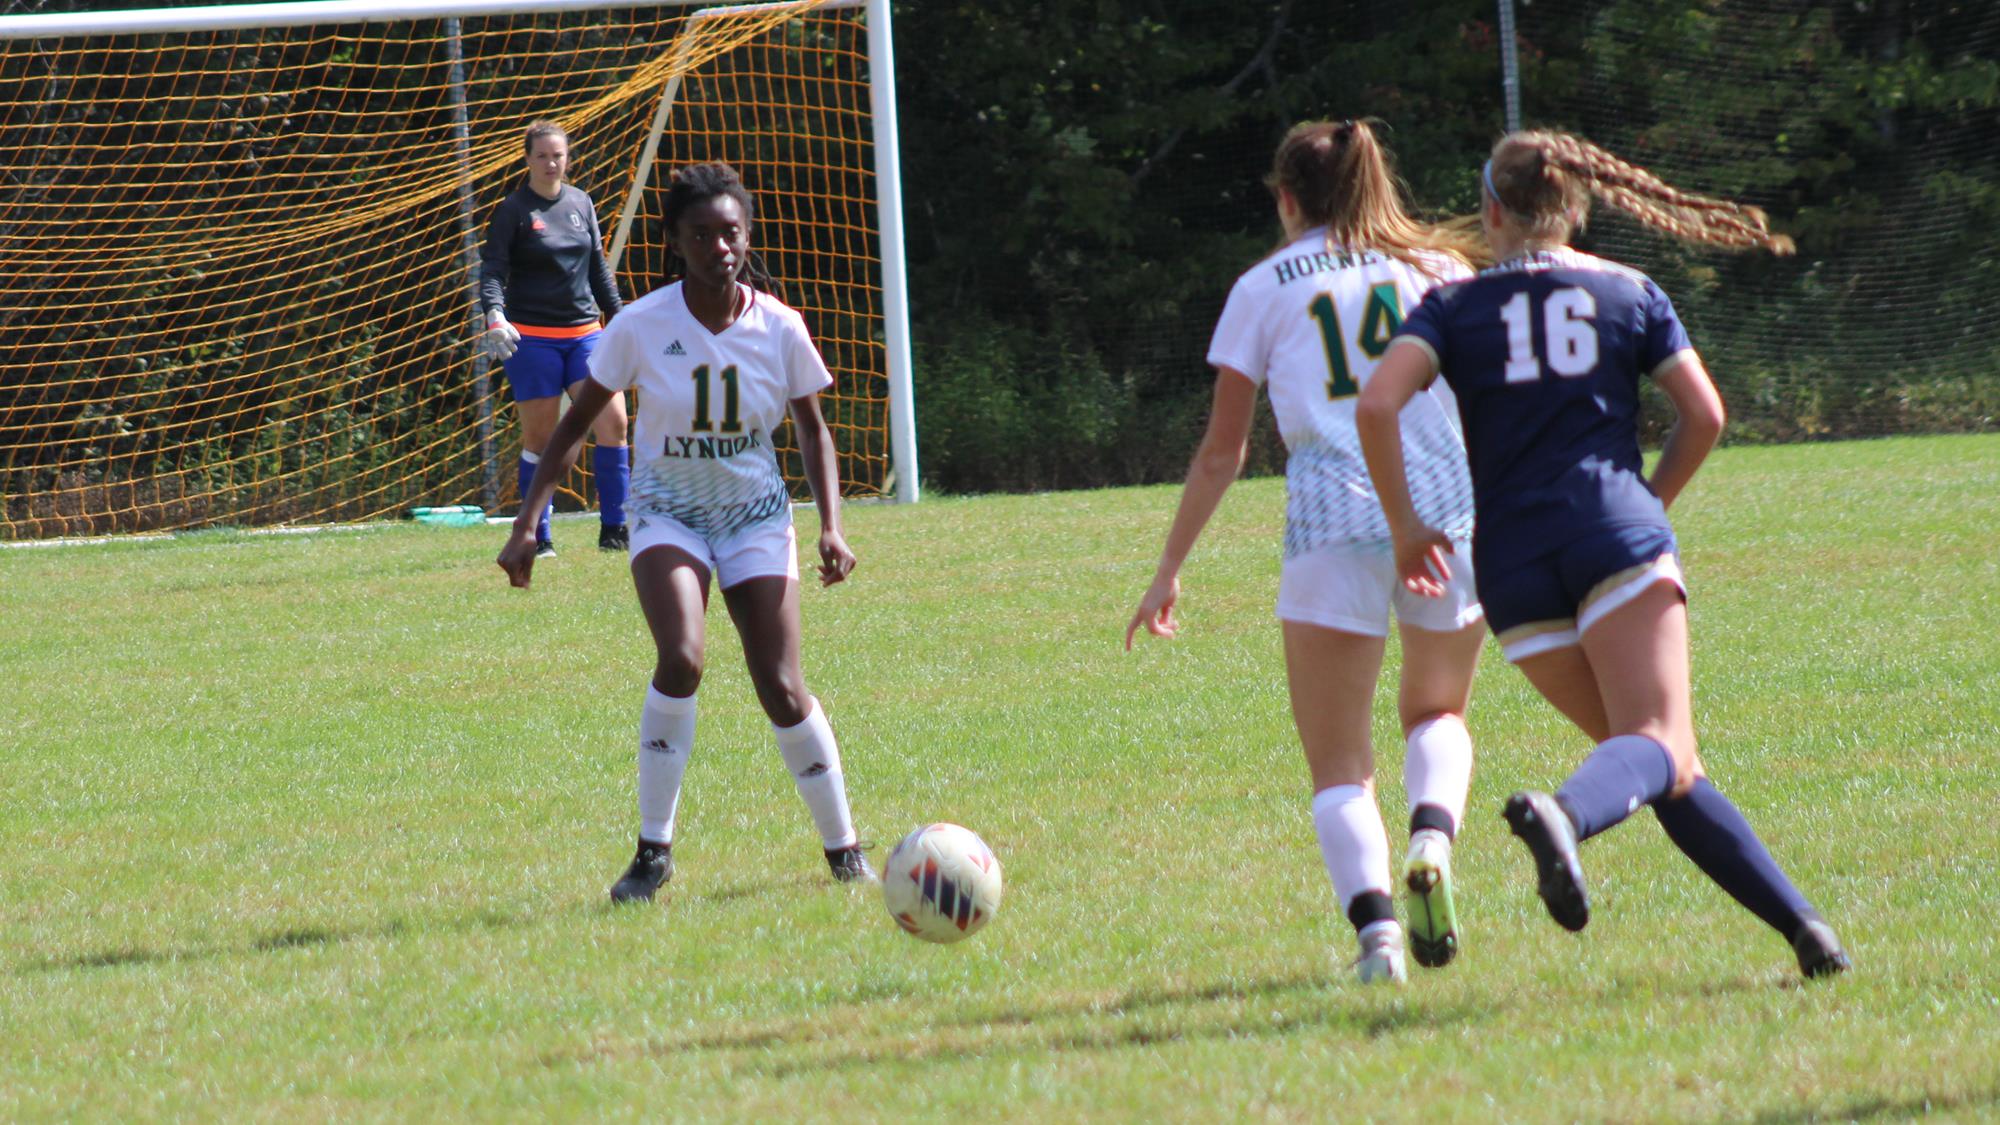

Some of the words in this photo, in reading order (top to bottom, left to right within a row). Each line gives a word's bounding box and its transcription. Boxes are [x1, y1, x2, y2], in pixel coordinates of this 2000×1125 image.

[1308, 281, 1406, 401] 14
[1500, 286, 1599, 383] 16
[692, 364, 742, 432] 11
